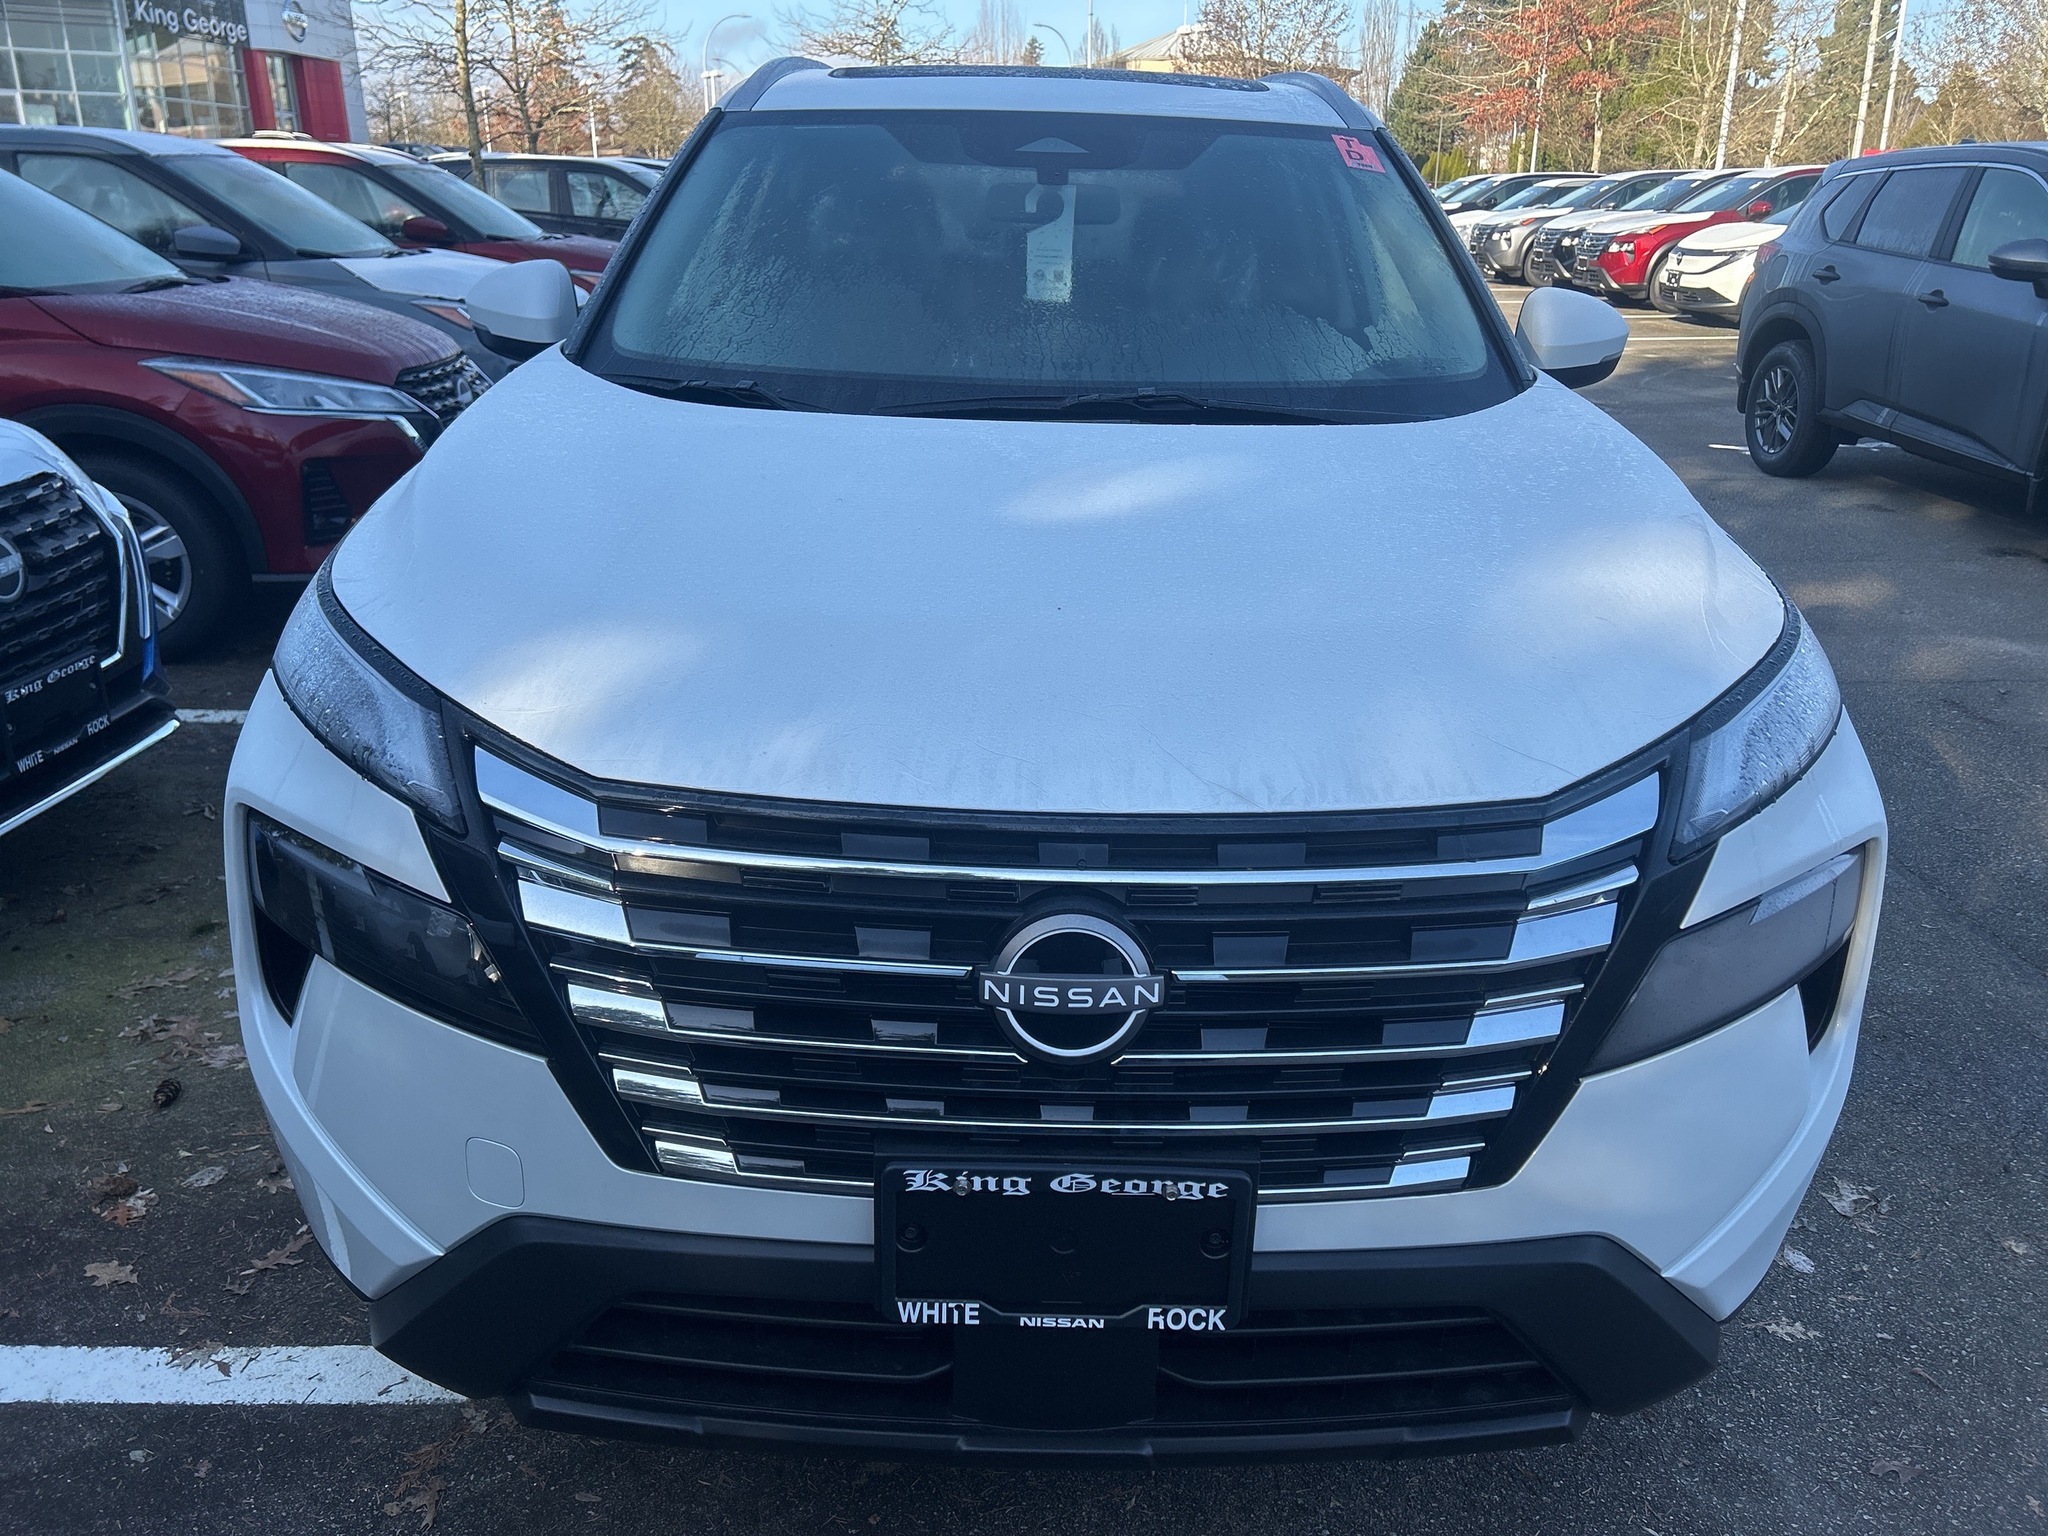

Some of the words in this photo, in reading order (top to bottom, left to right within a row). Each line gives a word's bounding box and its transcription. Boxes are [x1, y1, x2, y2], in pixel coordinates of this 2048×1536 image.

[134, 0, 179, 34] King
[183, 8, 247, 44] George
[5, 679, 43, 704] King
[47, 655, 95, 684] George
[17, 750, 44, 773] WHITE
[53, 738, 78, 755] NISSAN
[87, 715, 110, 736] ROCK
[983, 979, 1160, 1008] NISSAN
[903, 1169, 1032, 1196] King
[1049, 1173, 1230, 1200] George
[897, 1302, 980, 1326] WHITE
[1019, 1316, 1105, 1330] NISSAN
[1147, 1308, 1226, 1331] ROCK
